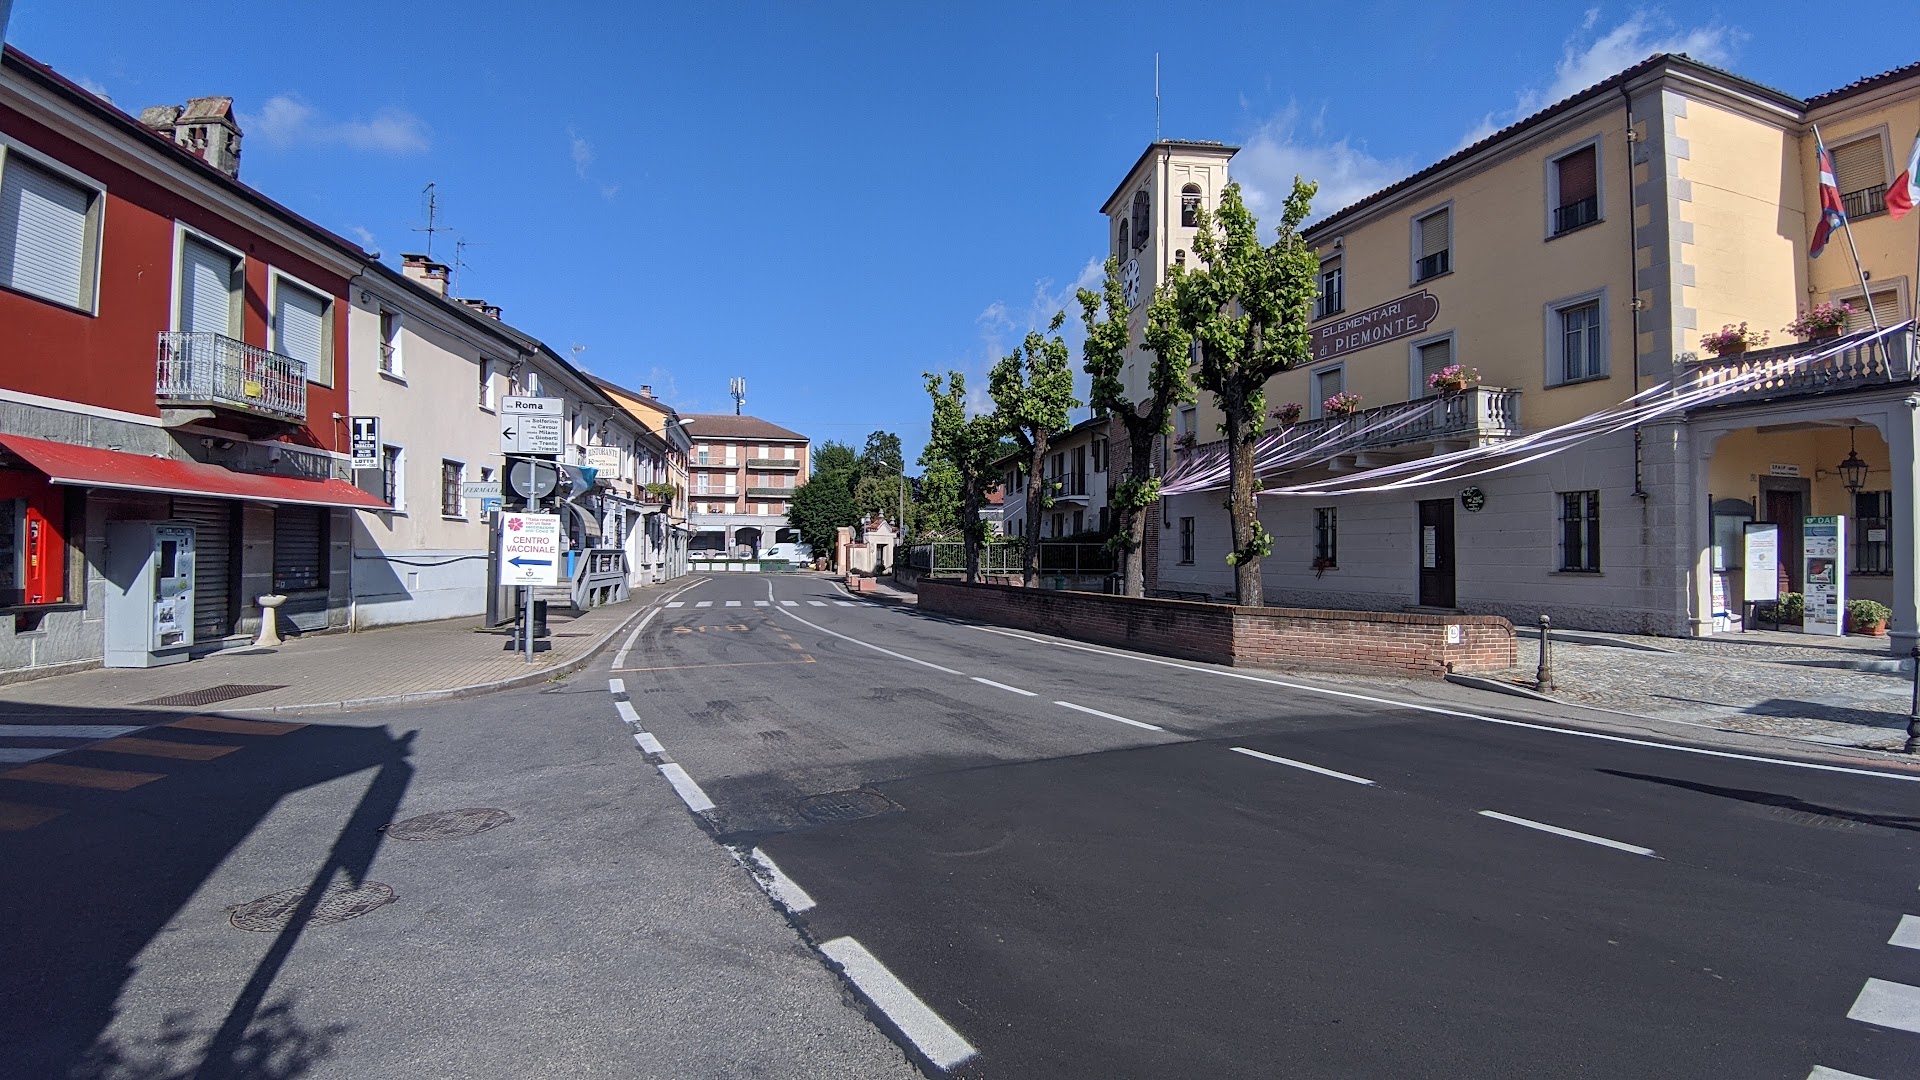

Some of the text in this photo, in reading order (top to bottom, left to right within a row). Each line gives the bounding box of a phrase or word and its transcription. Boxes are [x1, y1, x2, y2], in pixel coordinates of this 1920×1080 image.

[1322, 303, 1401, 338] ELEMENTARI
[1320, 345, 1328, 356] di
[1335, 314, 1418, 352] PIEMONTE
[515, 401, 543, 409] Roma
[588, 448, 618, 458] RISTORANTE
[506, 545, 556, 553] VACCINALE
